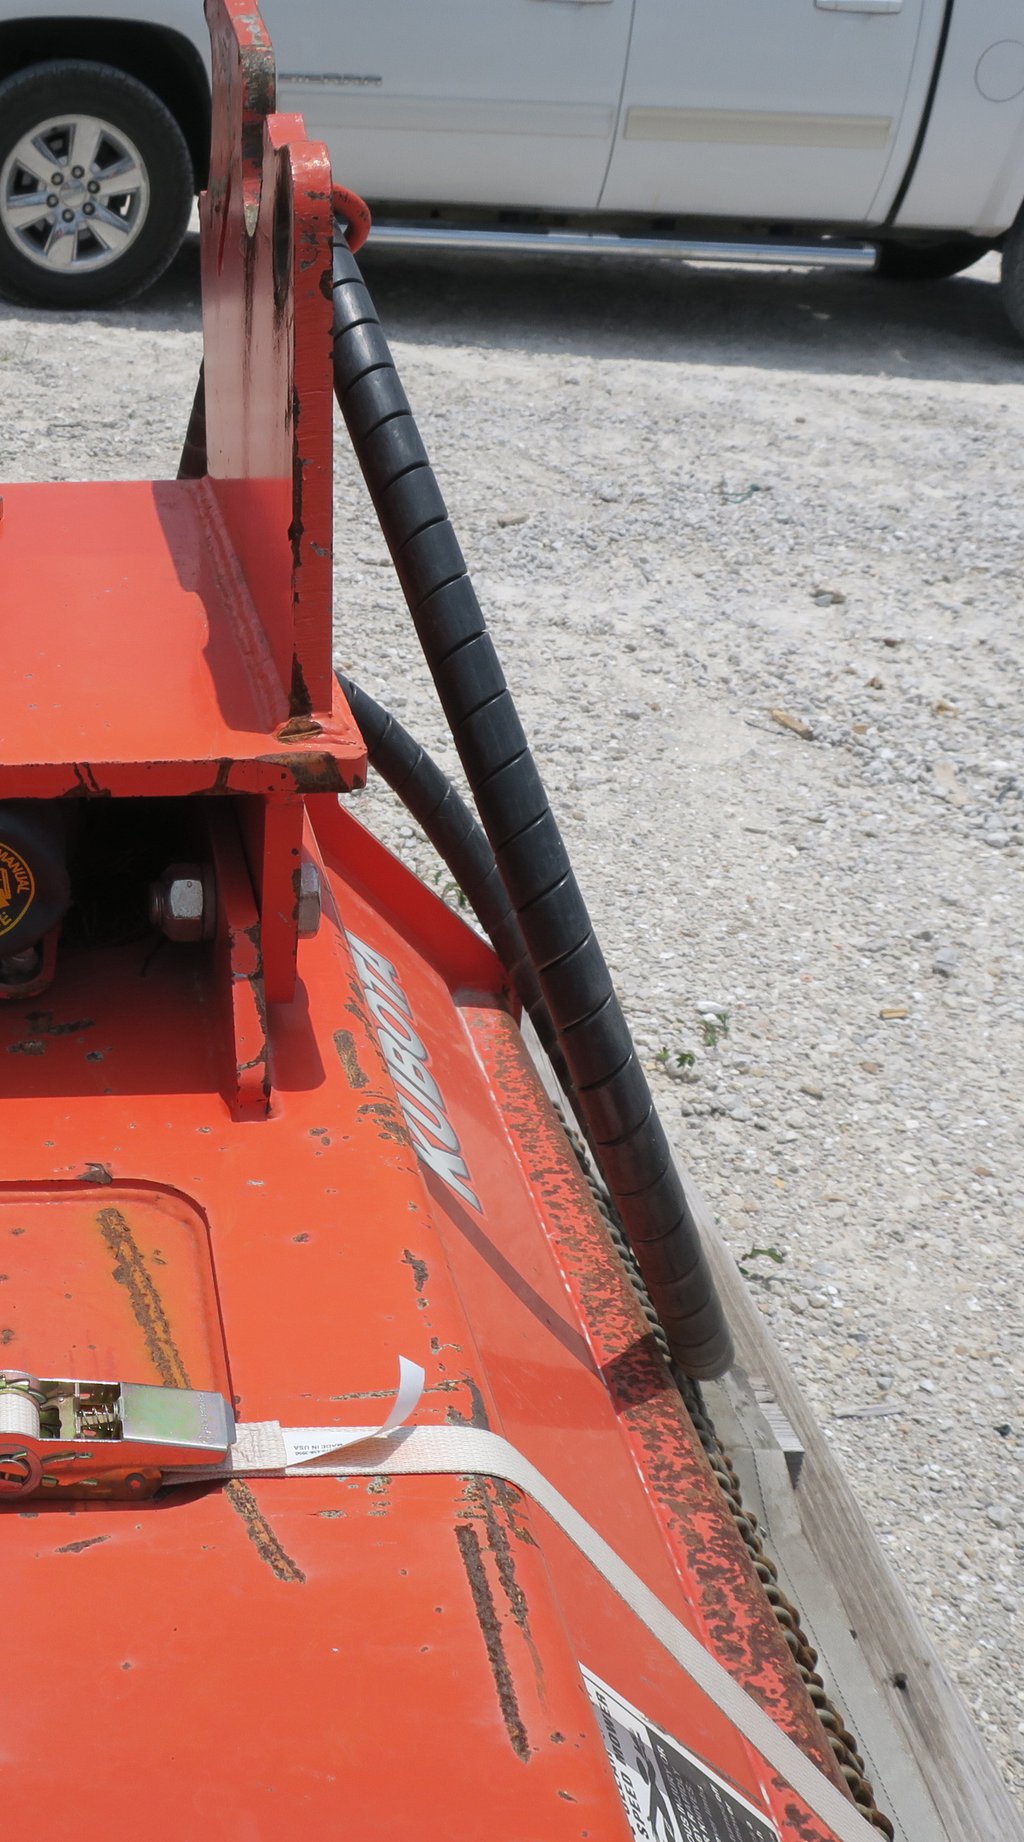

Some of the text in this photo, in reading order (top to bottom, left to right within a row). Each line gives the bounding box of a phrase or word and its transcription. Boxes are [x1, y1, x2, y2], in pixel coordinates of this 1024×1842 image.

[344, 928, 484, 1215] KUBOTA
[596, 1691, 627, 1767] MOWER
[657, 1744, 669, 1766] OR
[621, 1770, 650, 1840] SPEED
[671, 1767, 695, 1823] RAPIDLY
